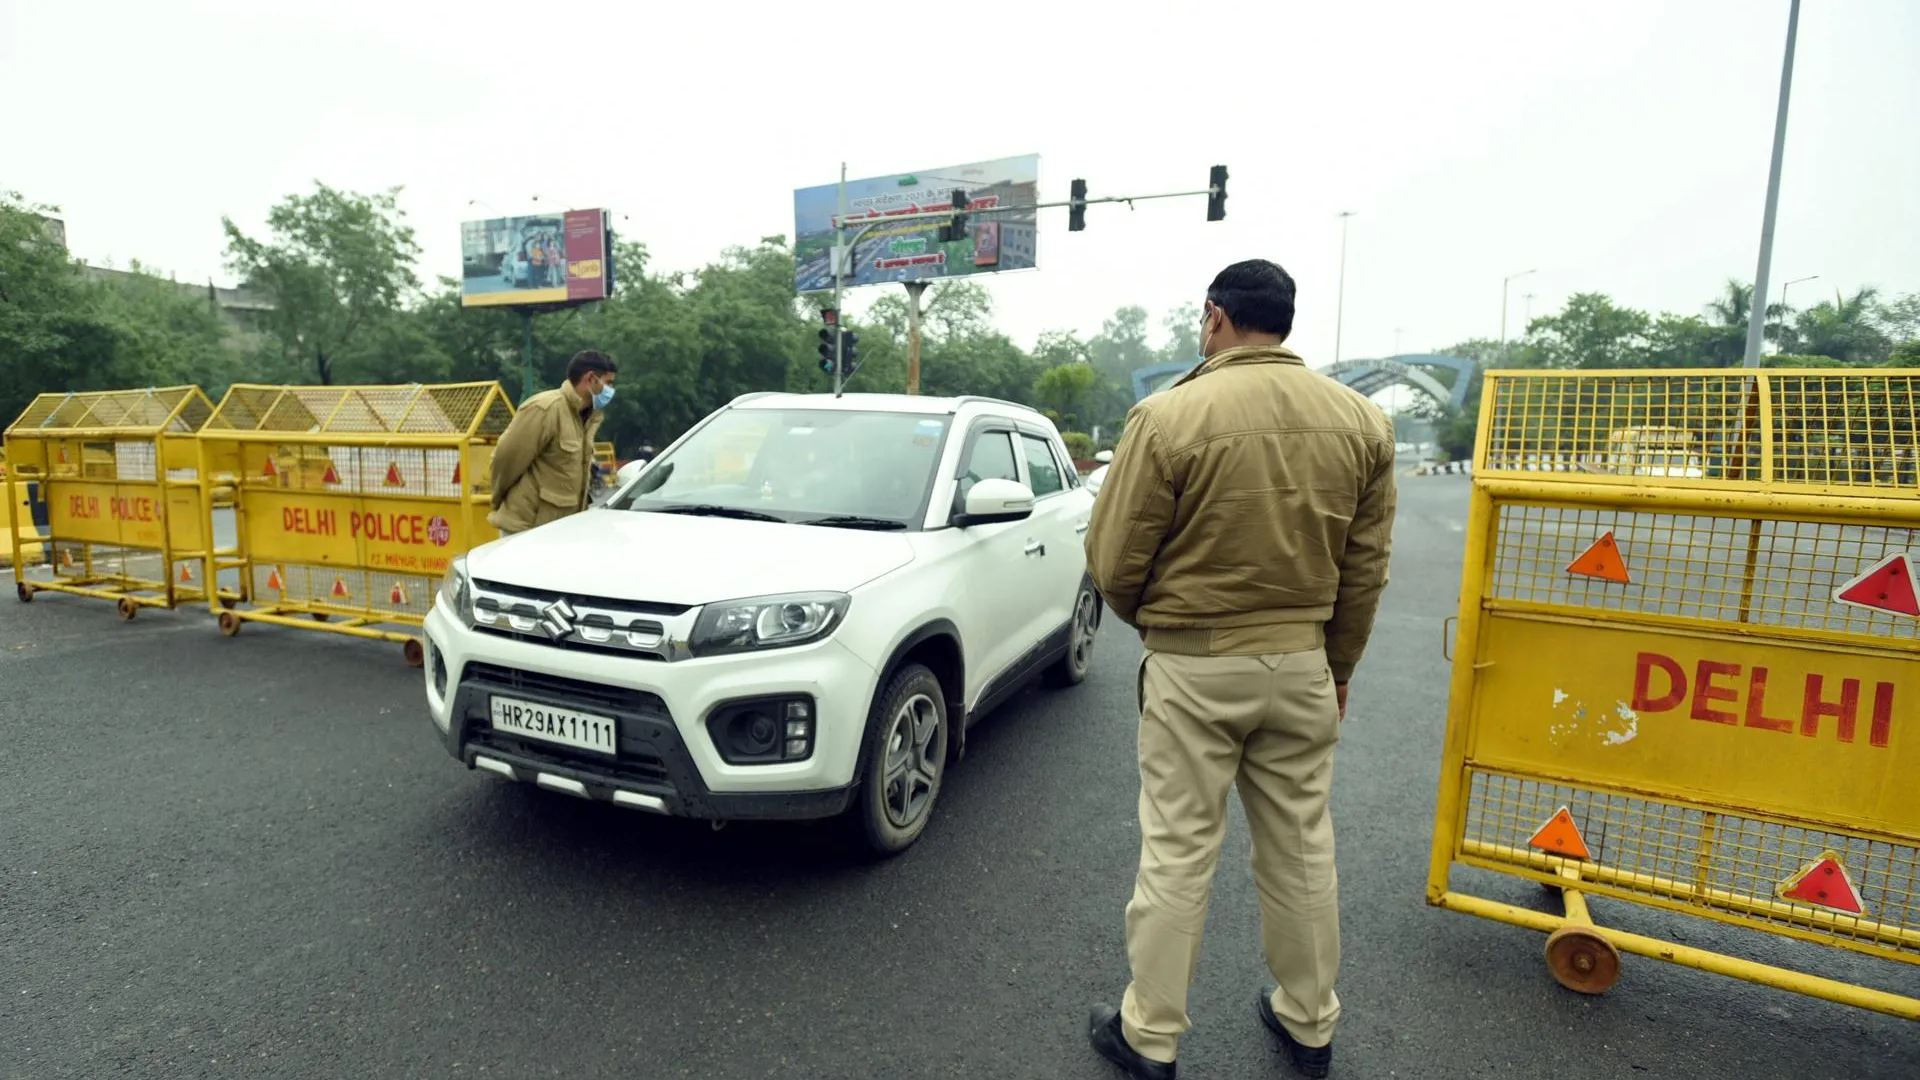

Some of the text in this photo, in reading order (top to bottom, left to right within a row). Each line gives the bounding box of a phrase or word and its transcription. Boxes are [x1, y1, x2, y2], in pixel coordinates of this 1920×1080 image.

[69, 495, 152, 522] DELHI POLICE
[282, 506, 336, 536] DELHI
[350, 511, 424, 545] POLICE
[1631, 652, 1894, 748] DELHI
[502, 703, 611, 747] HR29AX1111
